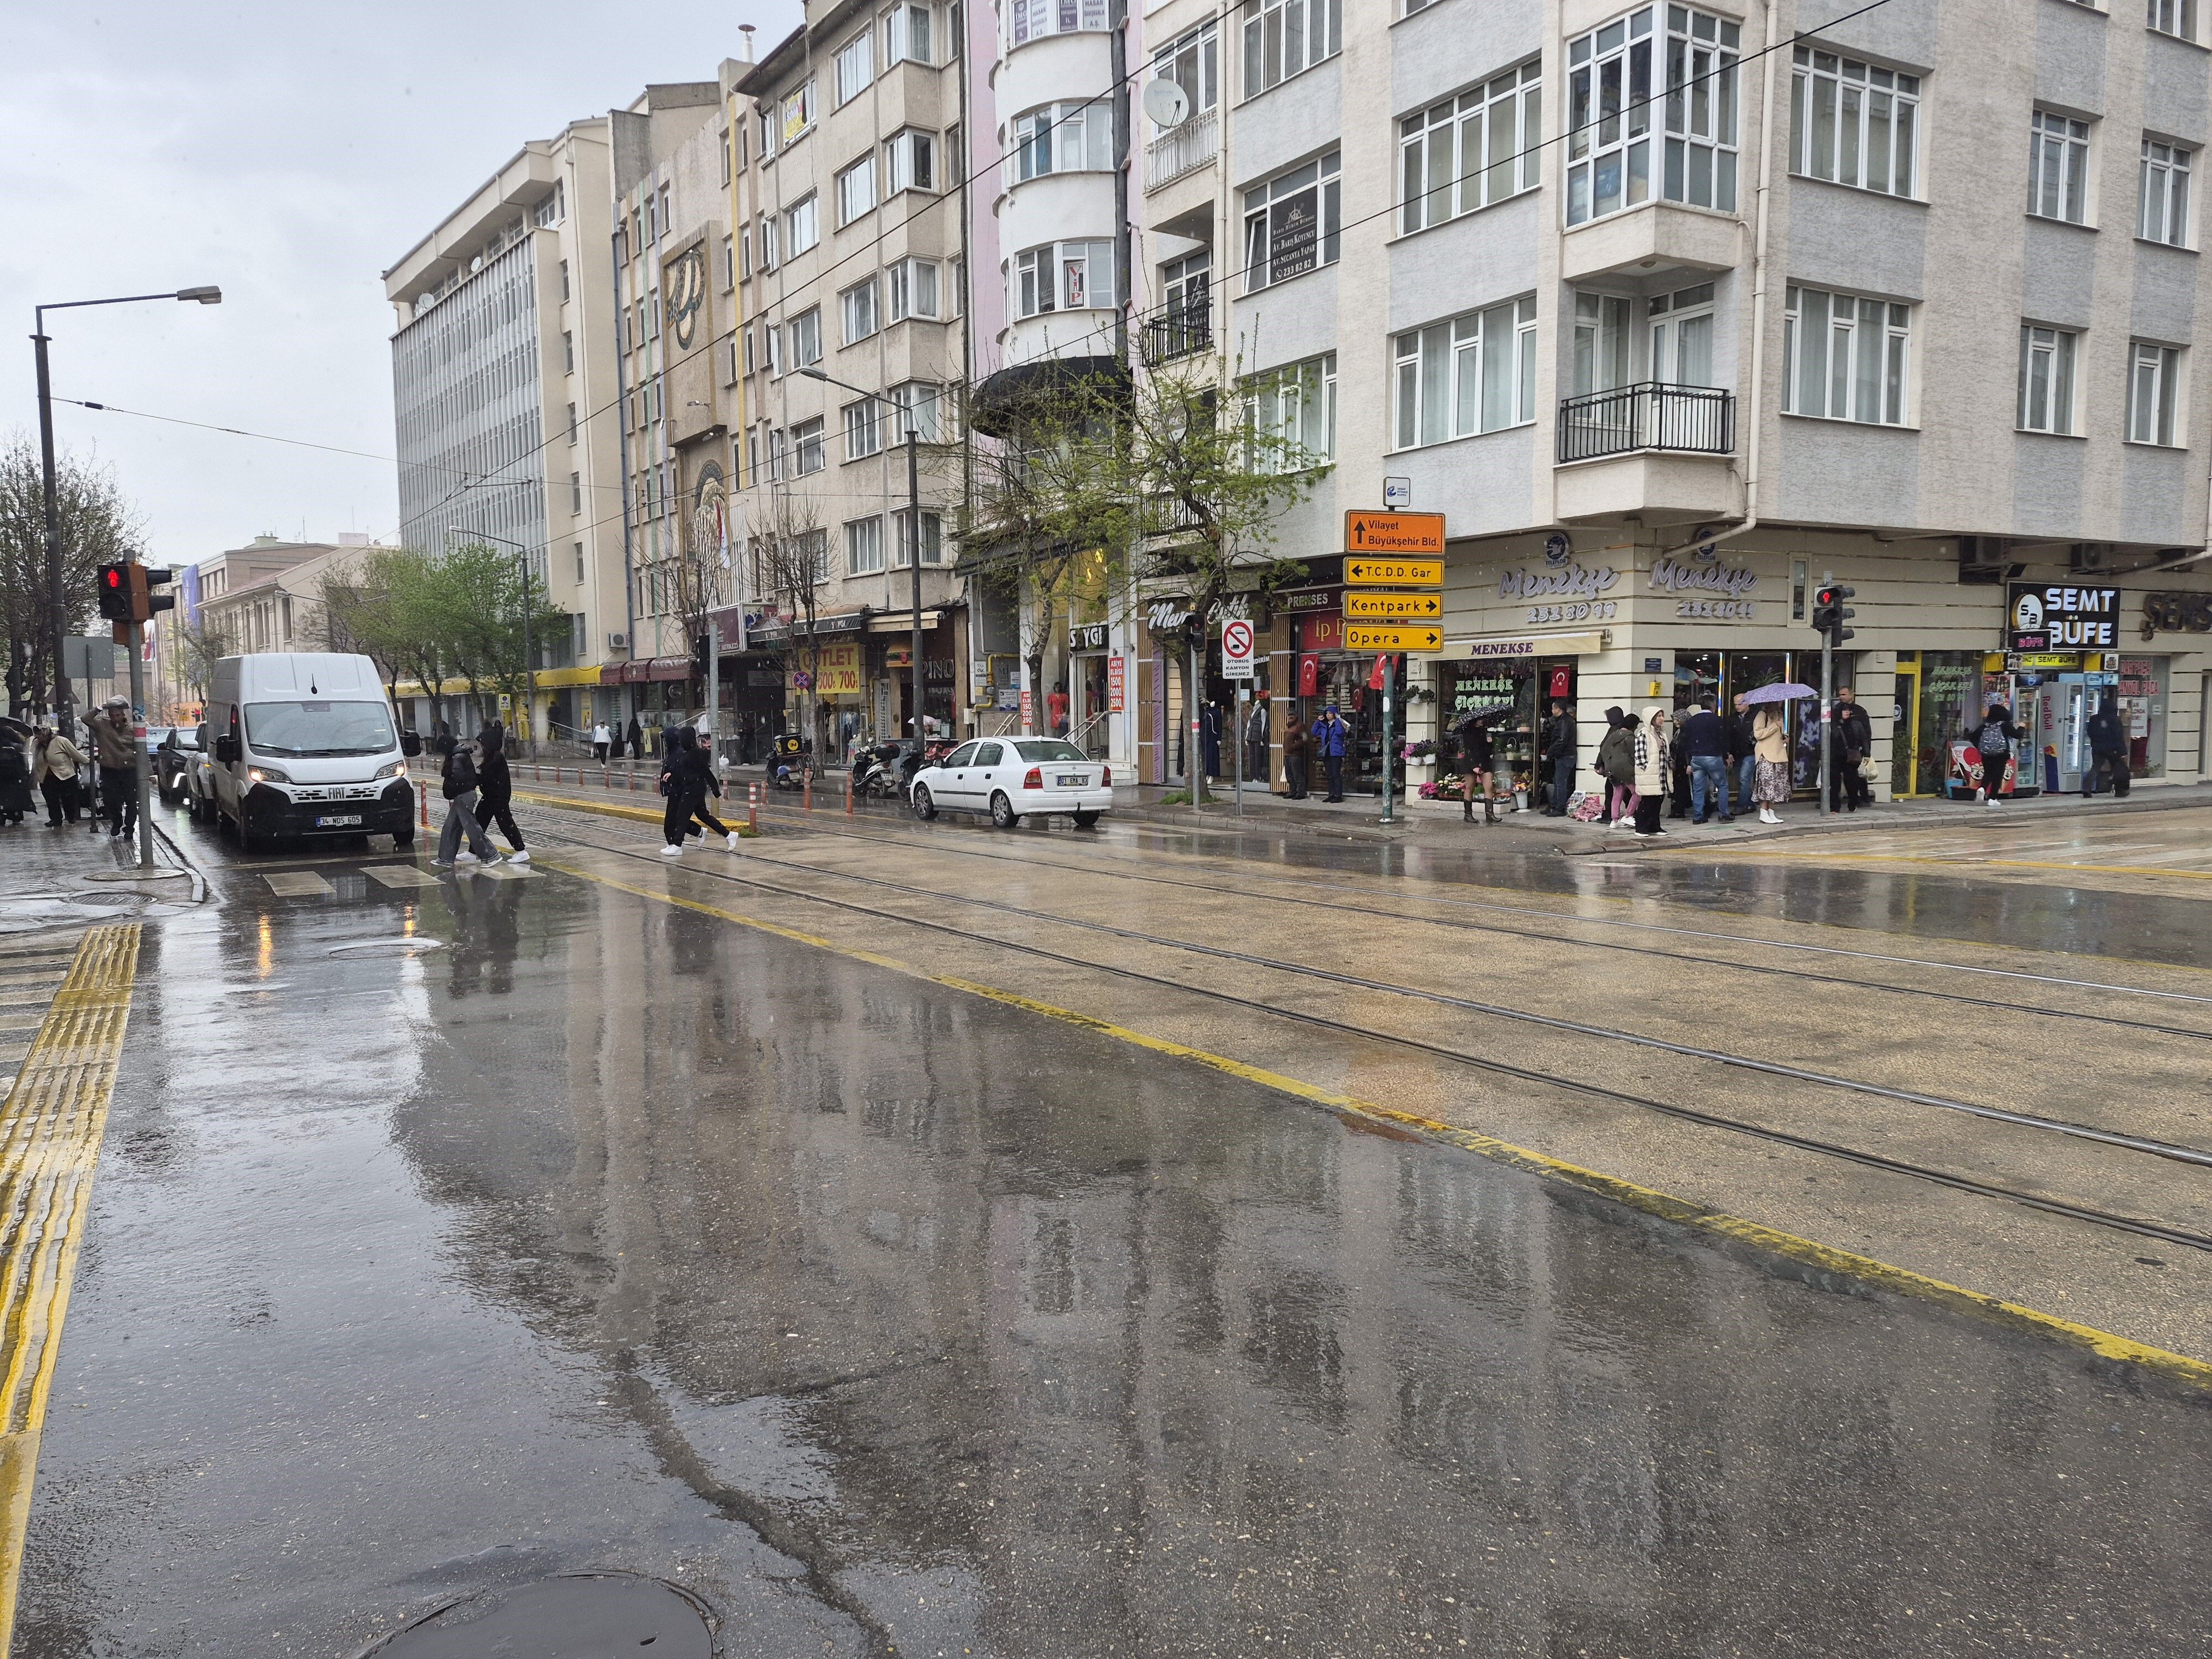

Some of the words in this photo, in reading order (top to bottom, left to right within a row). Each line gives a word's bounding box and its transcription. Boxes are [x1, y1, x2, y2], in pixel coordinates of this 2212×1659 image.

[1284, 265, 1294, 277] 233
[1295, 262, 1302, 273] 82
[1304, 258, 1311, 268] 82
[1368, 520, 1399, 531] Vilayet
[1368, 535, 1419, 547] Büyükşehir
[1422, 537, 1439, 546] Bld.
[1366, 566, 1407, 577] T.C.D.D.
[1411, 567, 1431, 577] Gar
[1498, 564, 1621, 600] Menekşe
[1648, 560, 1759, 599] Menekşe
[1287, 593, 1328, 608] PRENSES
[1351, 599, 1420, 614] Kentpark
[2046, 588, 2115, 612] SEMT
[1526, 606, 1561, 623] 231
[1565, 602, 1591, 619] 80
[1593, 602, 1618, 618] 99
[2047, 615, 2112, 644] BÜFE
[1350, 631, 1399, 646] Opera
[2018, 637, 2044, 648] BÜFE
[1471, 642, 1533, 655] MENEKŞE
[1254, 655, 1270, 664] DİRİM
[1455, 679, 1514, 692] MENEKŞE
[328, 787, 345, 800] FIAT
